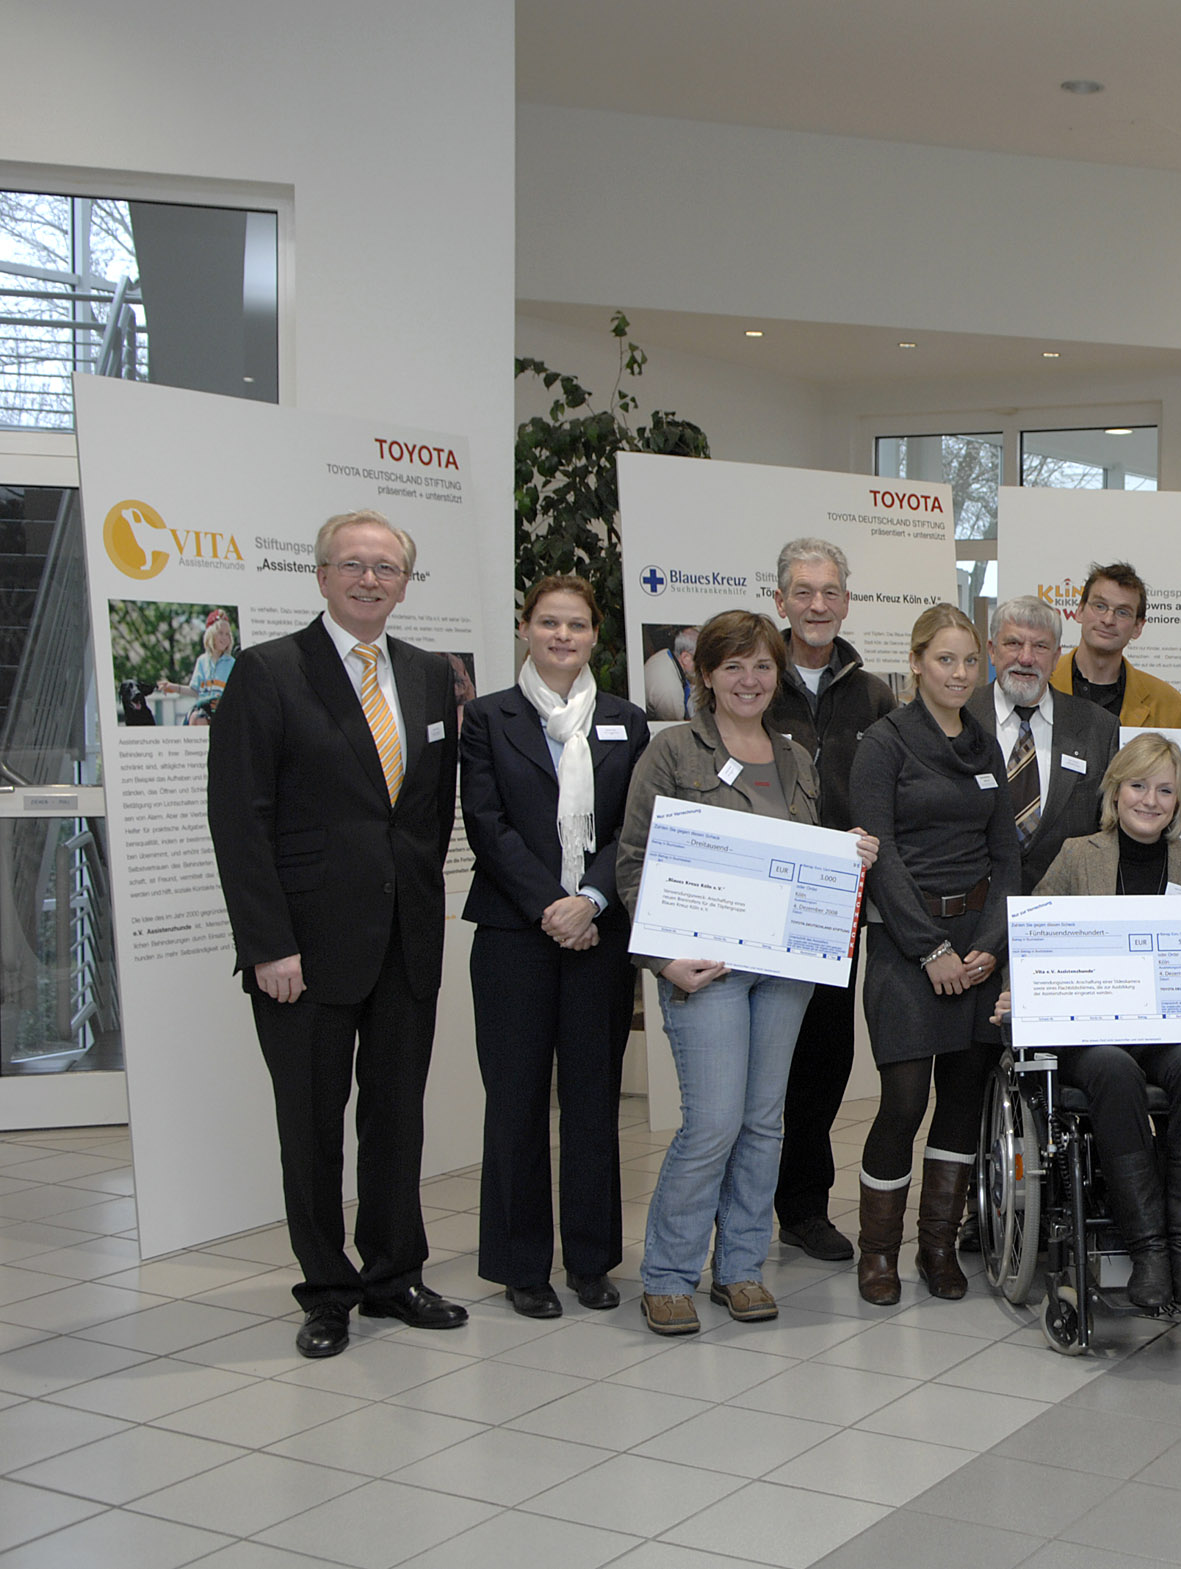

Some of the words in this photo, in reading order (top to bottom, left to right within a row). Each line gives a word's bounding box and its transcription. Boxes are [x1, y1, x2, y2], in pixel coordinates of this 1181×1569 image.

[374, 438, 459, 470] TOYOTA
[326, 463, 361, 477] TOYOTA
[362, 468, 423, 486] DEUTSCHLAND
[424, 477, 462, 491] STIFTUNG
[378, 485, 417, 498] präsentiert
[425, 492, 463, 504] unterstützt
[869, 490, 944, 513] TOYOTA
[827, 511, 857, 522] TOYOTA
[858, 515, 911, 527] DEUTSCHLAND
[912, 520, 945, 530] STIFTUNG
[871, 527, 906, 538] präsentiert
[912, 531, 946, 541] unterstützt
[169, 528, 245, 561] VITA
[178, 556, 246, 571] Assistenzhunde
[670, 569, 711, 585] Blaues
[712, 572, 747, 587] Kreuz
[671, 585, 747, 596] Suchtkrankenhilfe
[876, 593, 901, 603] Kreuz
[903, 593, 922, 604] Köln
[690, 838, 729, 852] Dreitausend
[775, 865, 789, 874] EUR
[146, 923, 192, 935] Assistenzhunde
